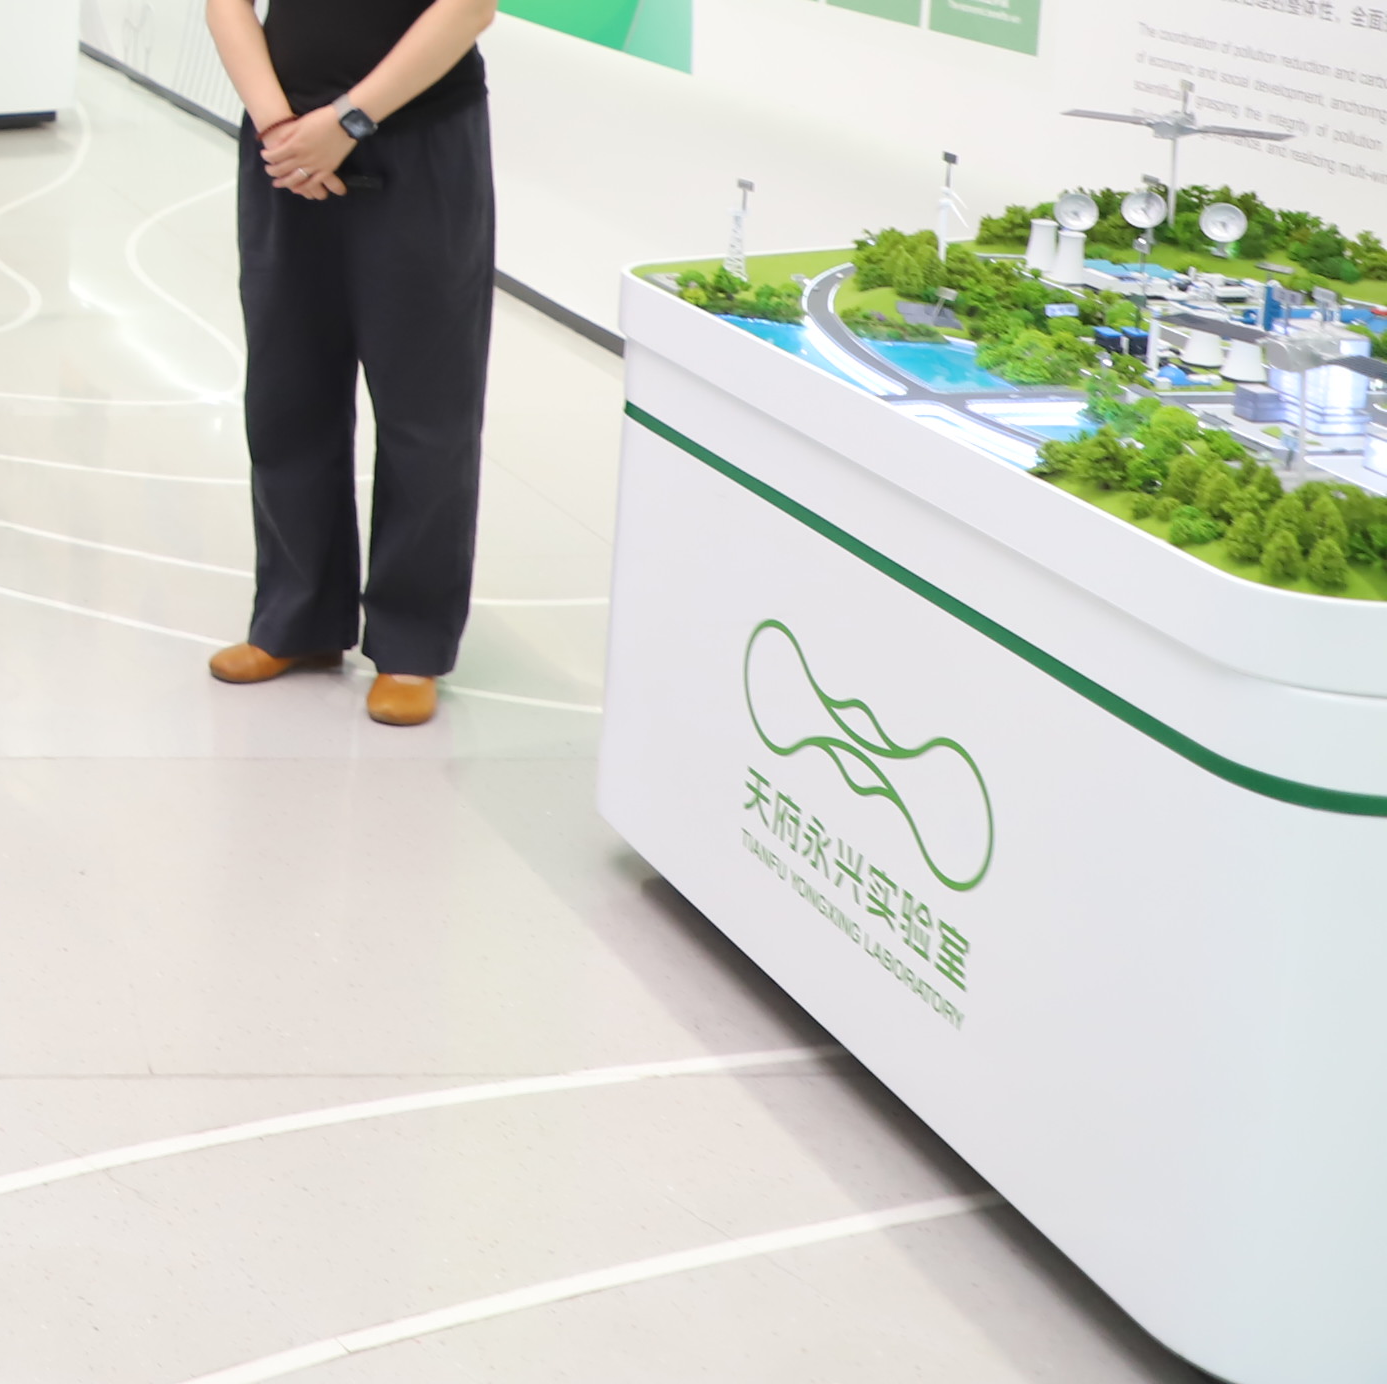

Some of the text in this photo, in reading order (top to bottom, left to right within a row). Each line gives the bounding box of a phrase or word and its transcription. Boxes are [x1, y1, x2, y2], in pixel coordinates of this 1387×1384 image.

[740, 827, 966, 1031] TIANFU YONGXING LABORATORY
[743, 765, 970, 992] 天府永兴实验室
